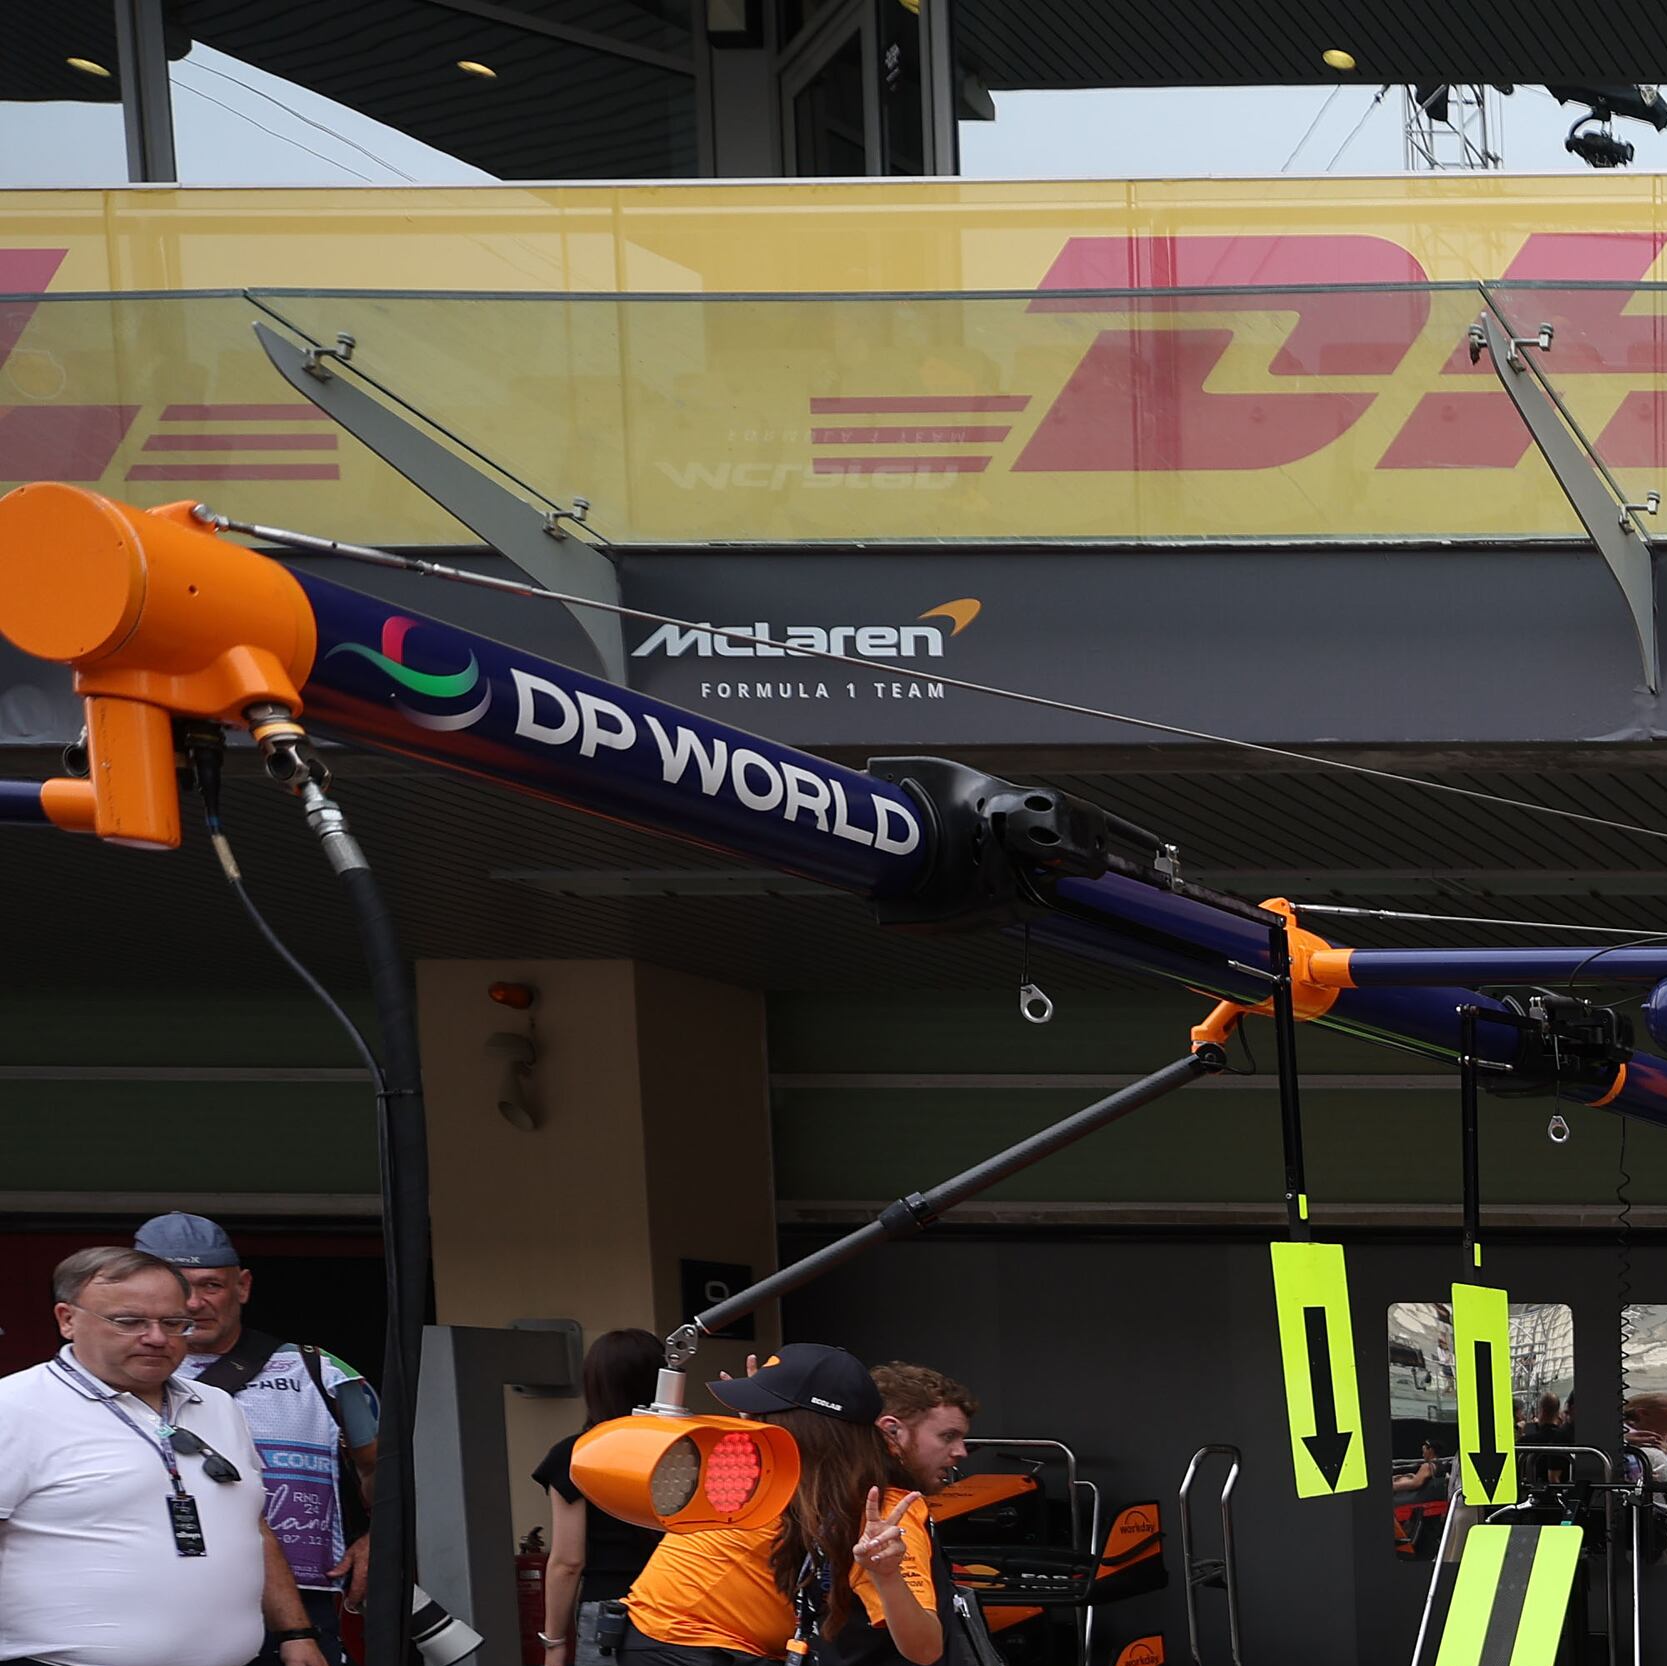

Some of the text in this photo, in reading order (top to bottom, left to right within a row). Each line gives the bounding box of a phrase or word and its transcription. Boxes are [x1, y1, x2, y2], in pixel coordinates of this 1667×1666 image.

[631, 621, 945, 658] McLaren
[701, 682, 945, 699] FORMULA 1 TEAM
[511, 667, 921, 857] DP WORLD
